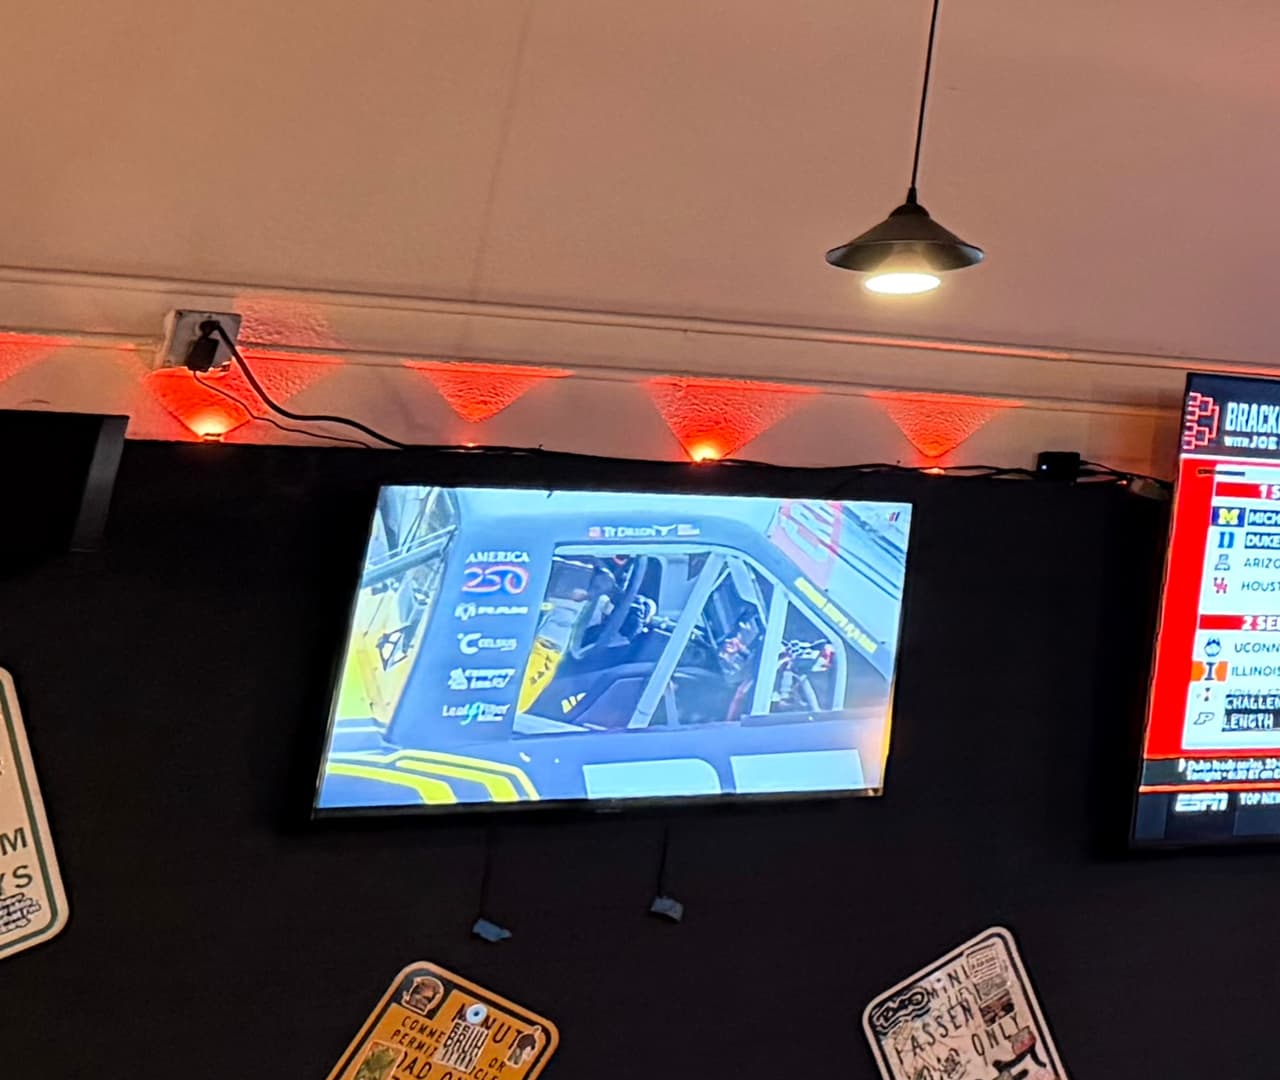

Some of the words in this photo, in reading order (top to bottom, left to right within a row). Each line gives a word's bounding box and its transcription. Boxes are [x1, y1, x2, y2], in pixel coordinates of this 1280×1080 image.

[1250, 436, 1277, 449] JOE
[1259, 485, 1268, 498] 1
[1246, 535, 1280, 548] DUKE
[466, 551, 530, 563] AMERICA
[461, 565, 530, 594] 250
[1242, 616, 1253, 630] 2
[1234, 643, 1280, 653] UCONN
[1223, 714, 1274, 729] LENGTH
[1176, 792, 1229, 812] ESPN
[1239, 792, 1260, 805] TOP
[971, 1014, 1023, 1057] ONLY
[488, 1057, 505, 1074] OR
